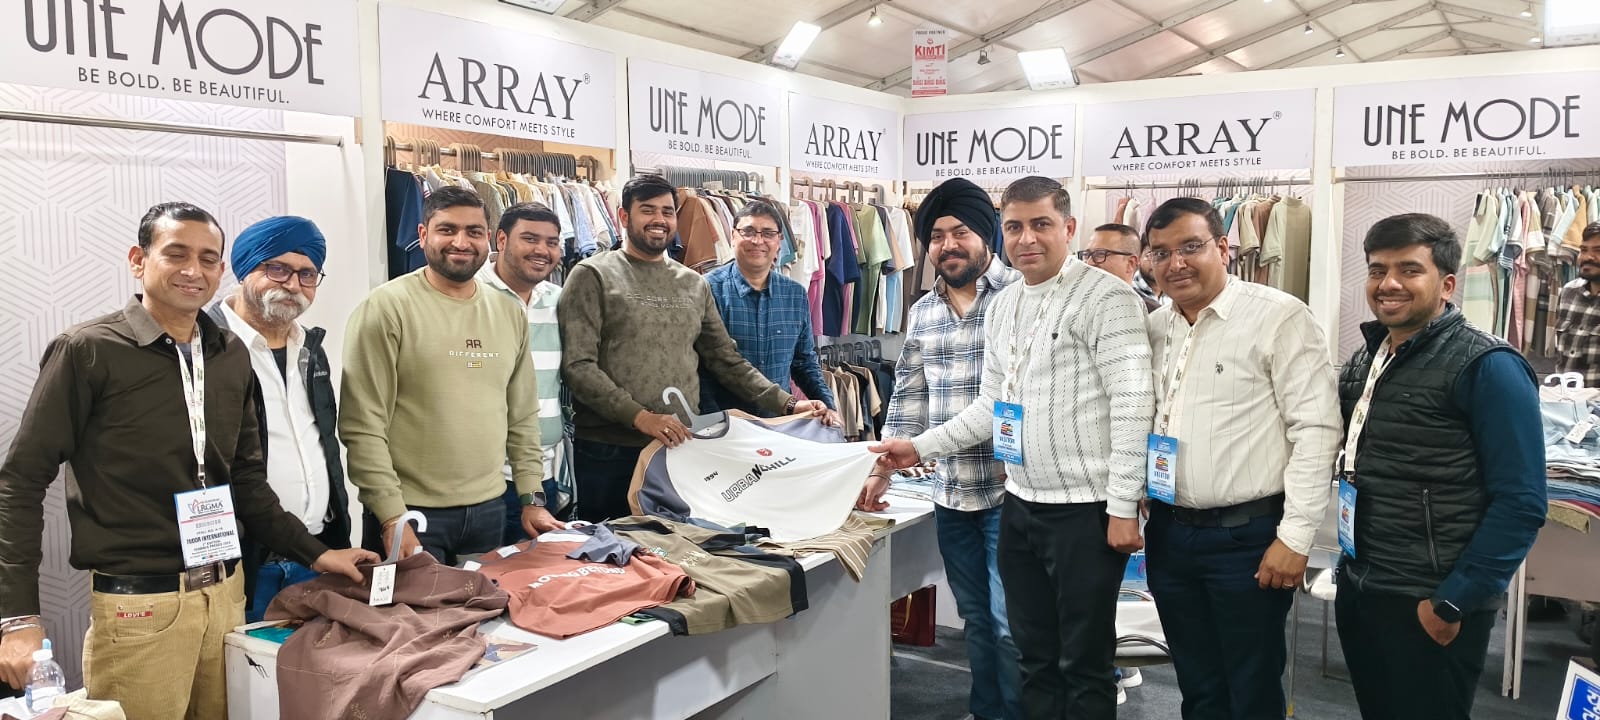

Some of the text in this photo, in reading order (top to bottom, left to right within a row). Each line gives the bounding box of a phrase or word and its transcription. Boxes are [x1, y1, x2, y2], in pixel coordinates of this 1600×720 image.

[24, 0, 325, 85] UNE MODE
[914, 44, 946, 56] KIMTI
[78, 66, 290, 104] BE BOLD. BE BEAUTIFUL.
[418, 51, 582, 121] ARRAY
[422, 108, 575, 138] WHERE COMFORT MEETS STYLE
[649, 86, 766, 146] UNE MODE
[1364, 95, 1580, 146] UNE MODE
[668, 140, 753, 159] BE BOLD. BE BEAUTIFUL.
[804, 121, 883, 162] ARRAY
[916, 124, 1063, 166] UNE MODE
[1110, 117, 1272, 160] ARRAY
[1391, 146, 1546, 160] BE BOLD. BE BEAUTIFUL.
[823, 161, 848, 171] COMFORT
[935, 165, 1040, 177] BE BOLD. BE BEAUTIFUL.
[1112, 157, 1262, 171] WHERE COMFORT MEETS STYLE
[449, 350, 501, 358] DIFFERENT
[703, 470, 718, 482] 1994
